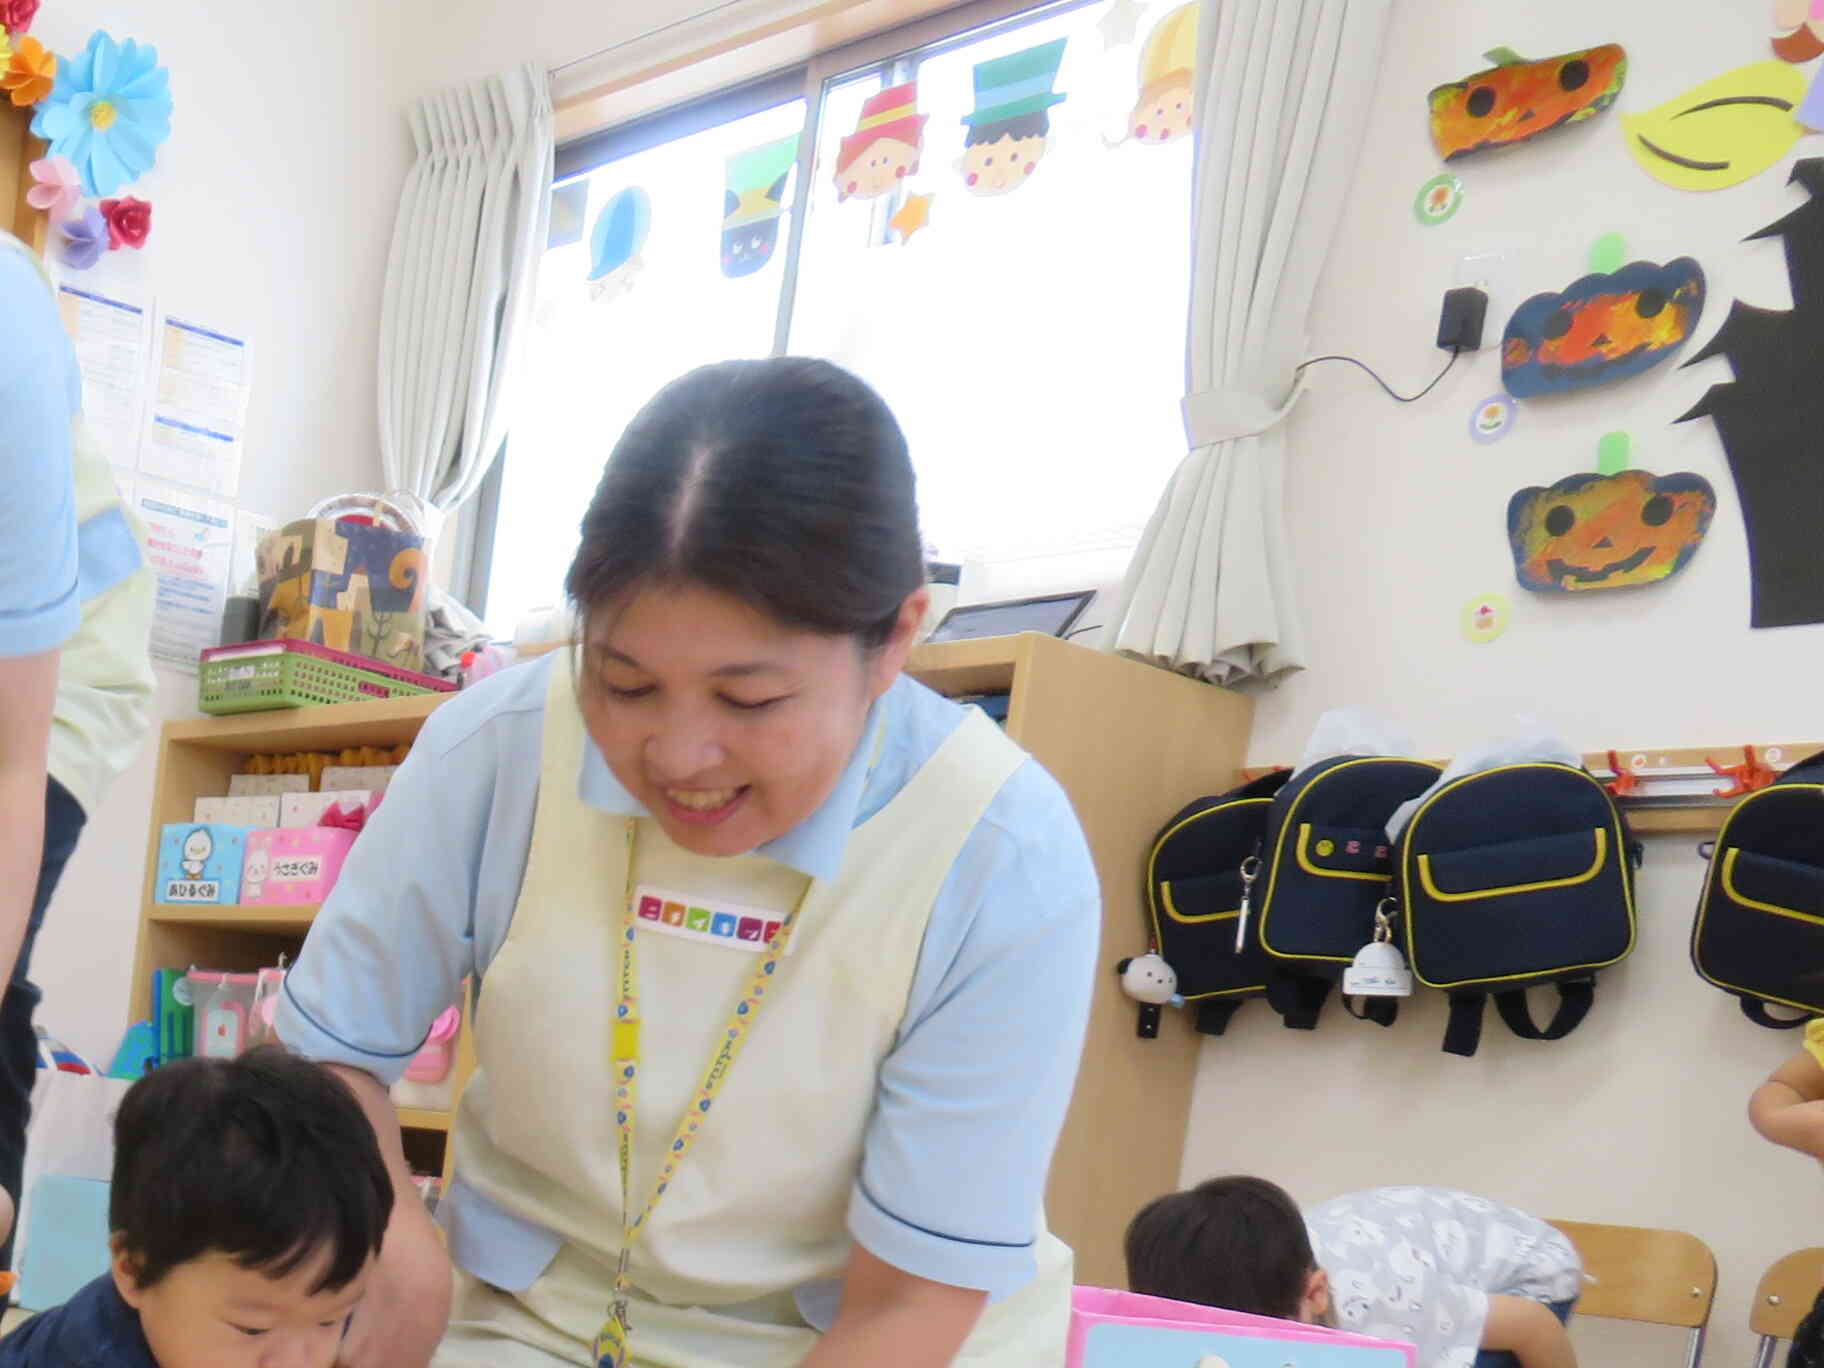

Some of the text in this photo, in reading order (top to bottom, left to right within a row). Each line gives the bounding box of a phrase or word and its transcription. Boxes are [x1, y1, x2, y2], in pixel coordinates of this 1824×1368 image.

[273, 860, 319, 877] うさぎぐみ
[168, 882, 217, 898] あひるぐみ
